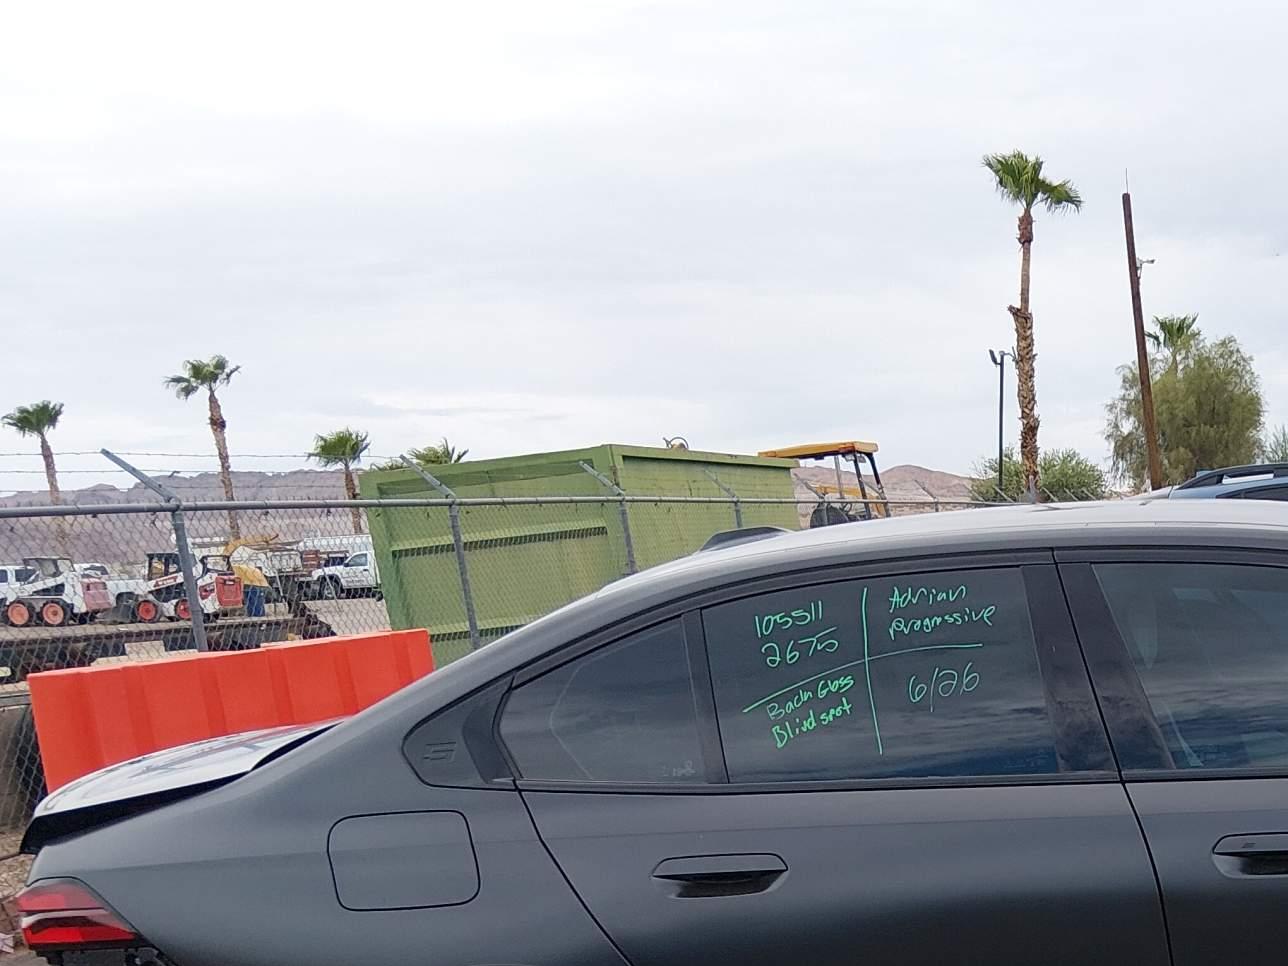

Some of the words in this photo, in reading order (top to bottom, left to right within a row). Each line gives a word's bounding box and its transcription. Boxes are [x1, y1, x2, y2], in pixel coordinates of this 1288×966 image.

[889, 585, 966, 613] Adrian
[755, 600, 822, 638] 105511
[761, 627, 839, 667] 2675
[908, 662, 980, 712] 6/26
